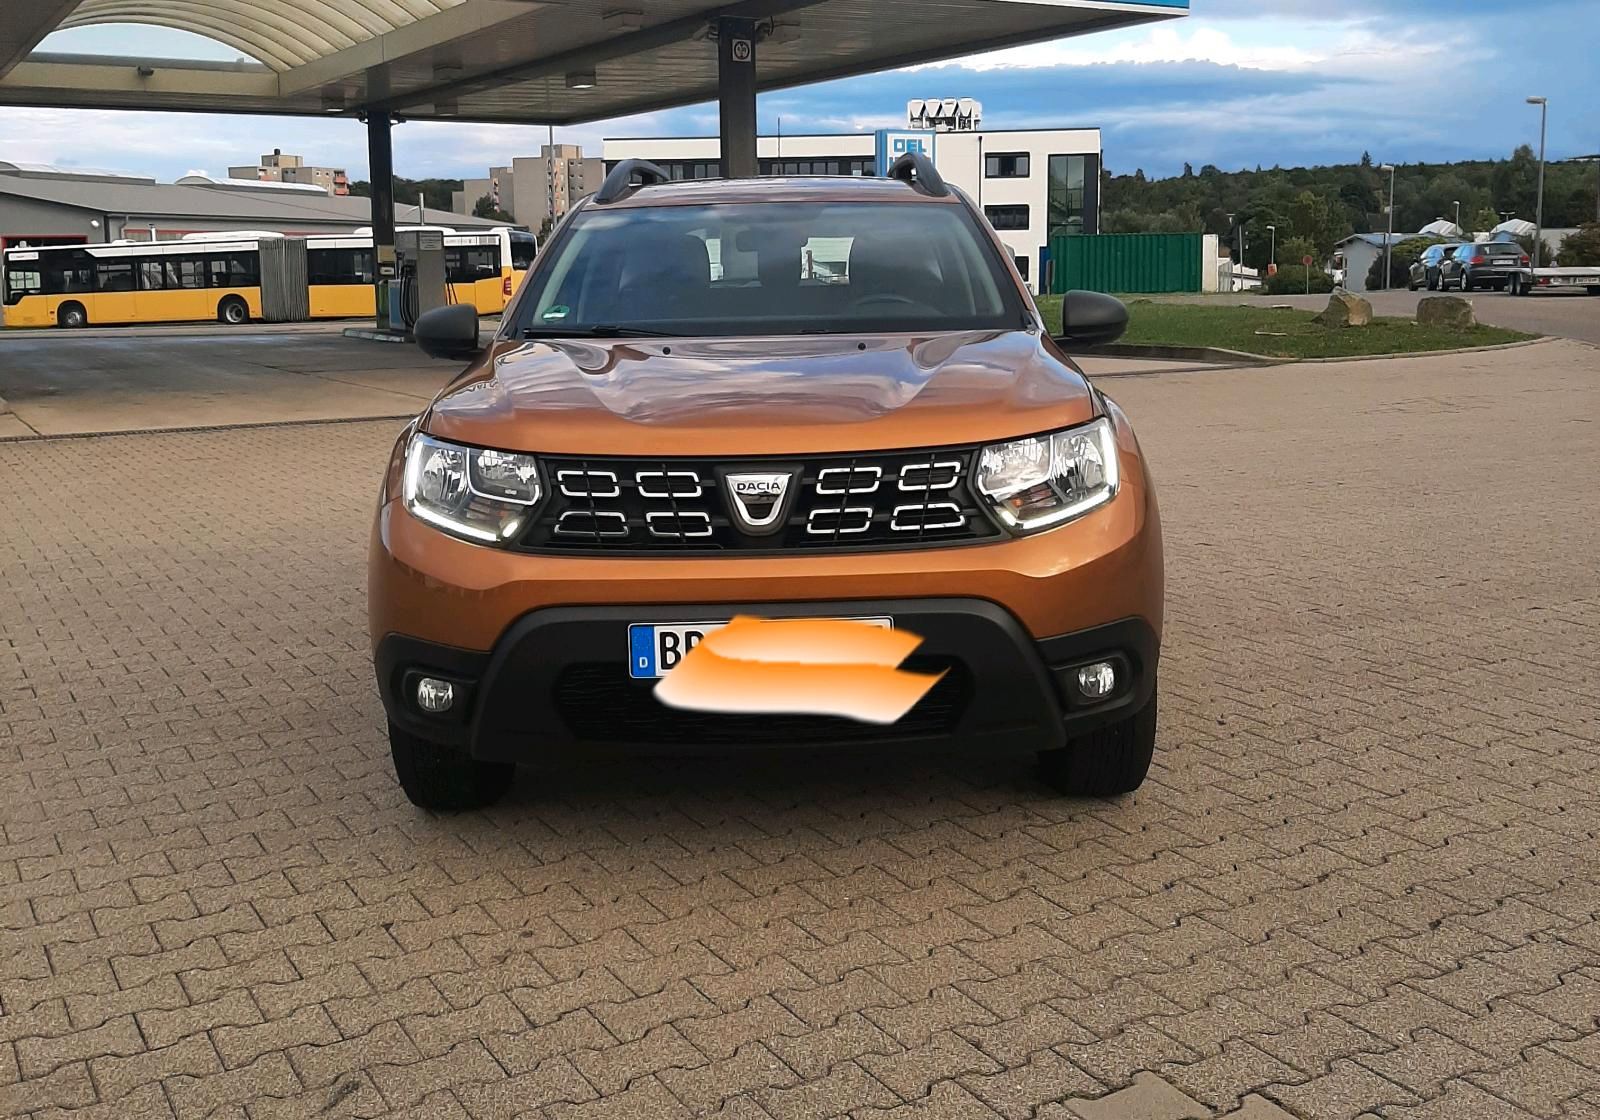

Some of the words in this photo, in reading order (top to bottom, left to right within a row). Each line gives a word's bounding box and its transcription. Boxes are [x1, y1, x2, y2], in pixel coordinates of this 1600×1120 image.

[893, 138, 928, 153] OEL
[736, 482, 781, 491] DACIA
[639, 656, 649, 668] D
